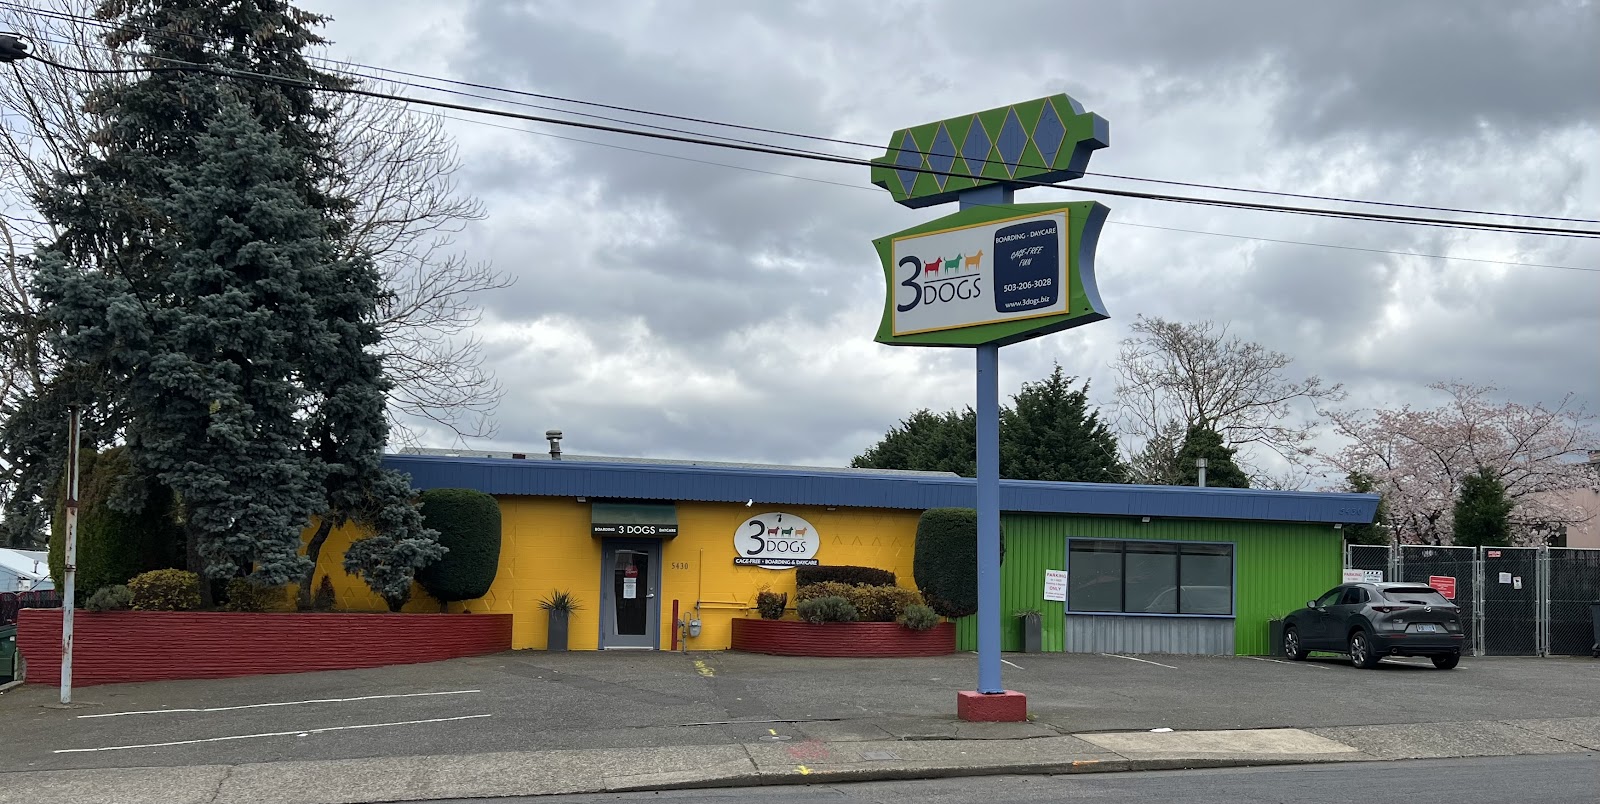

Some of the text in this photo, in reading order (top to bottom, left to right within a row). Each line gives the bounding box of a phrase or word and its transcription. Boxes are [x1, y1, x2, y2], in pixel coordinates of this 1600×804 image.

[995, 233, 1026, 244] BOARDING
[1030, 227, 1056, 238] DAYCARE
[1010, 246, 1044, 260] CAGE-FREE
[1019, 258, 1033, 267] FUN
[897, 255, 981, 312] 3 DOGS
[1003, 278, 1051, 292] 503-206-3028
[1005, 296, 1050, 308] www.3dogs.biz
[618, 525, 625, 534] 3
[627, 525, 656, 534] DOGS
[747, 520, 806, 555] 3 DOGS
[671, 562, 688, 570] 5430
